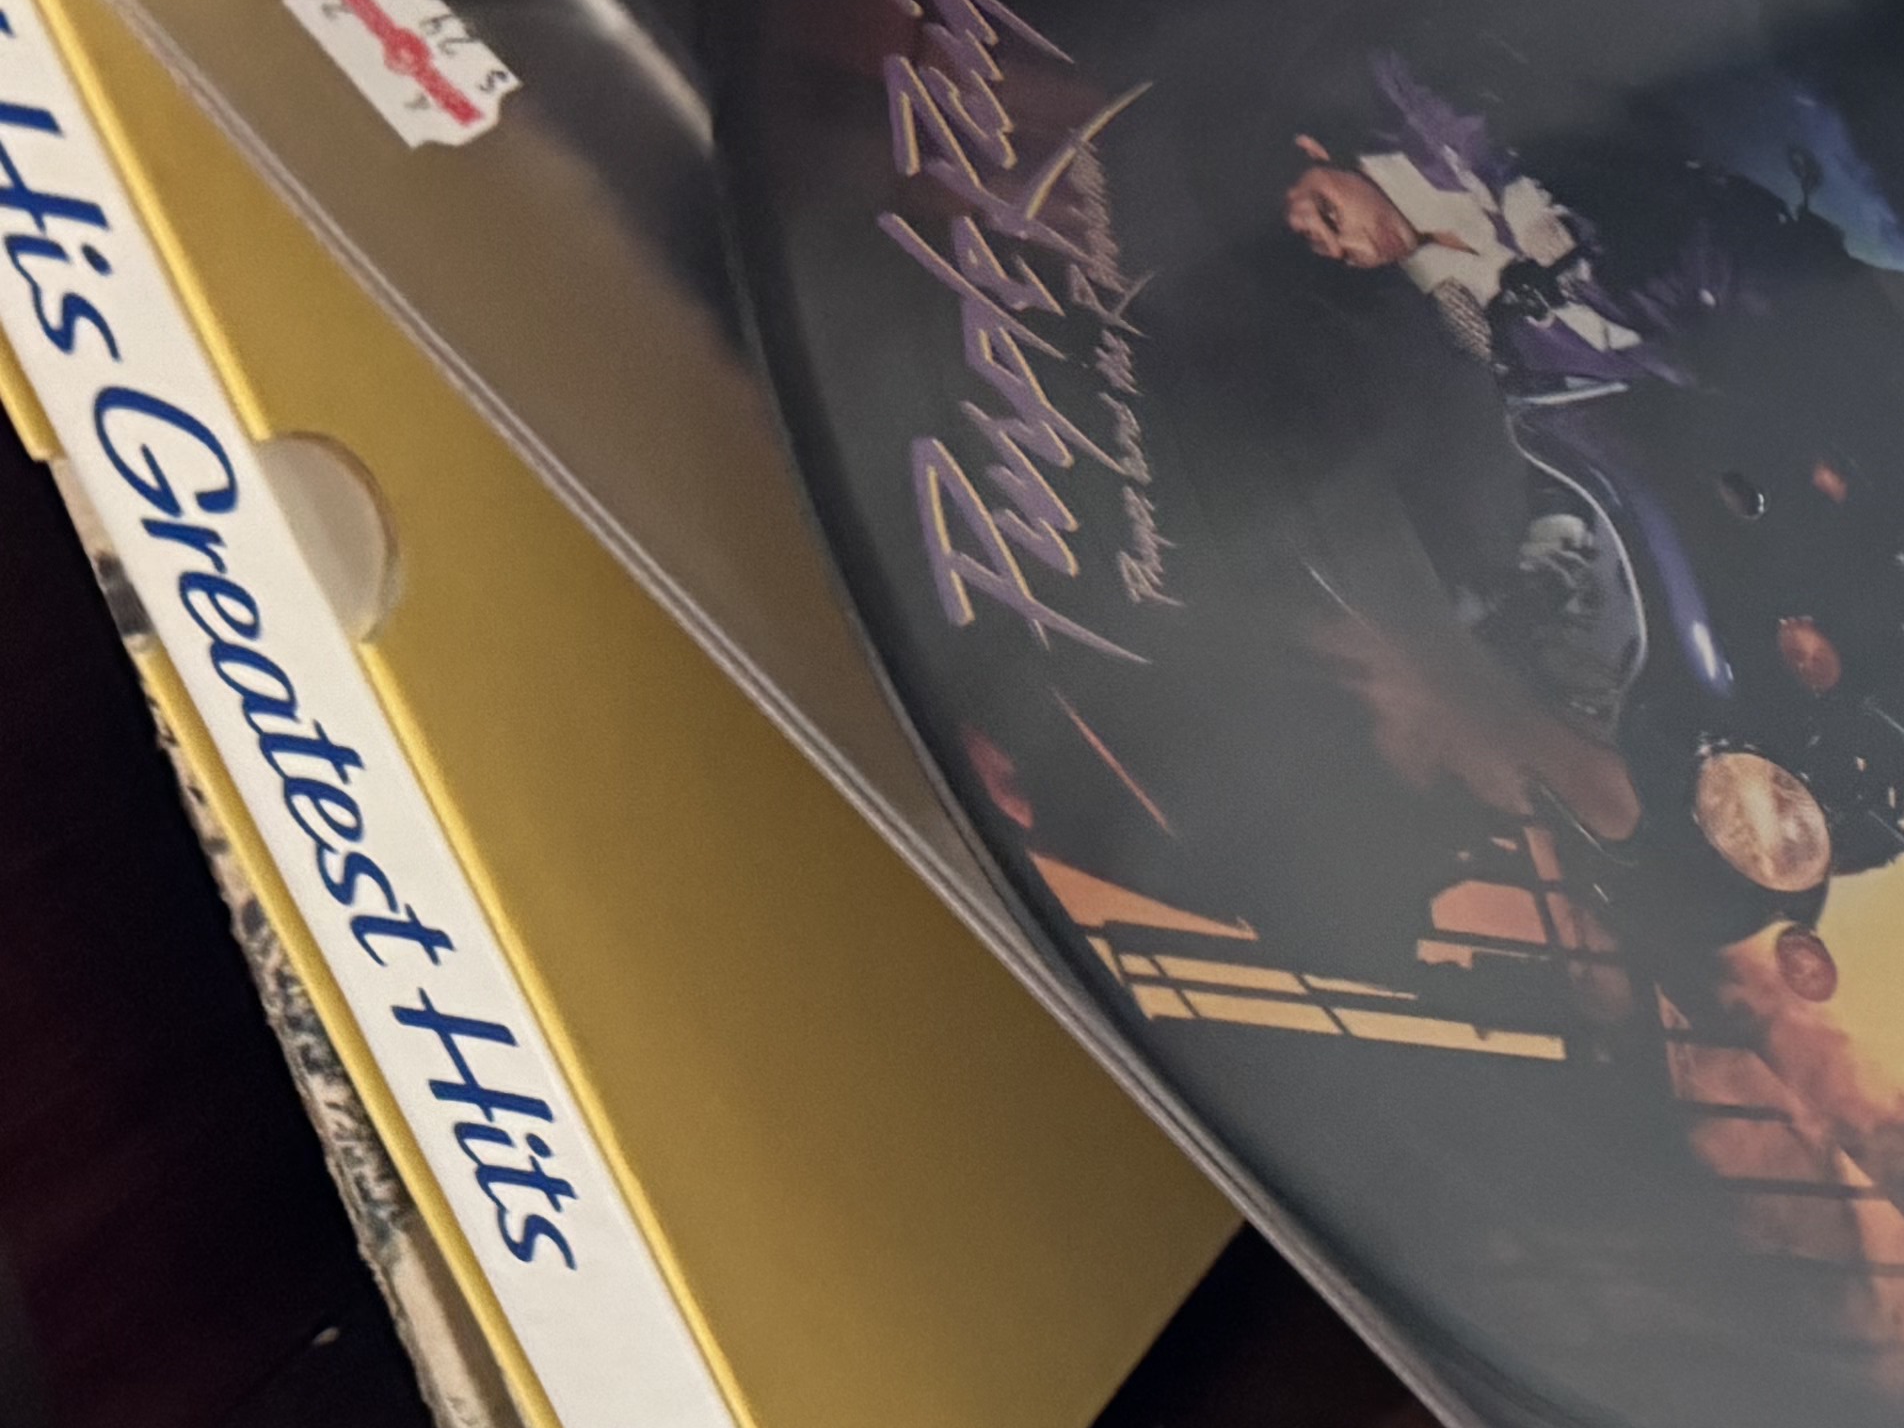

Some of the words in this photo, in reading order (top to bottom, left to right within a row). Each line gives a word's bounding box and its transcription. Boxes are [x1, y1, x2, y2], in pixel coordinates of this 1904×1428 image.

[0, 99, 123, 364] His
[93, 386, 458, 968] Greatest
[390, 988, 579, 1272] Hits
